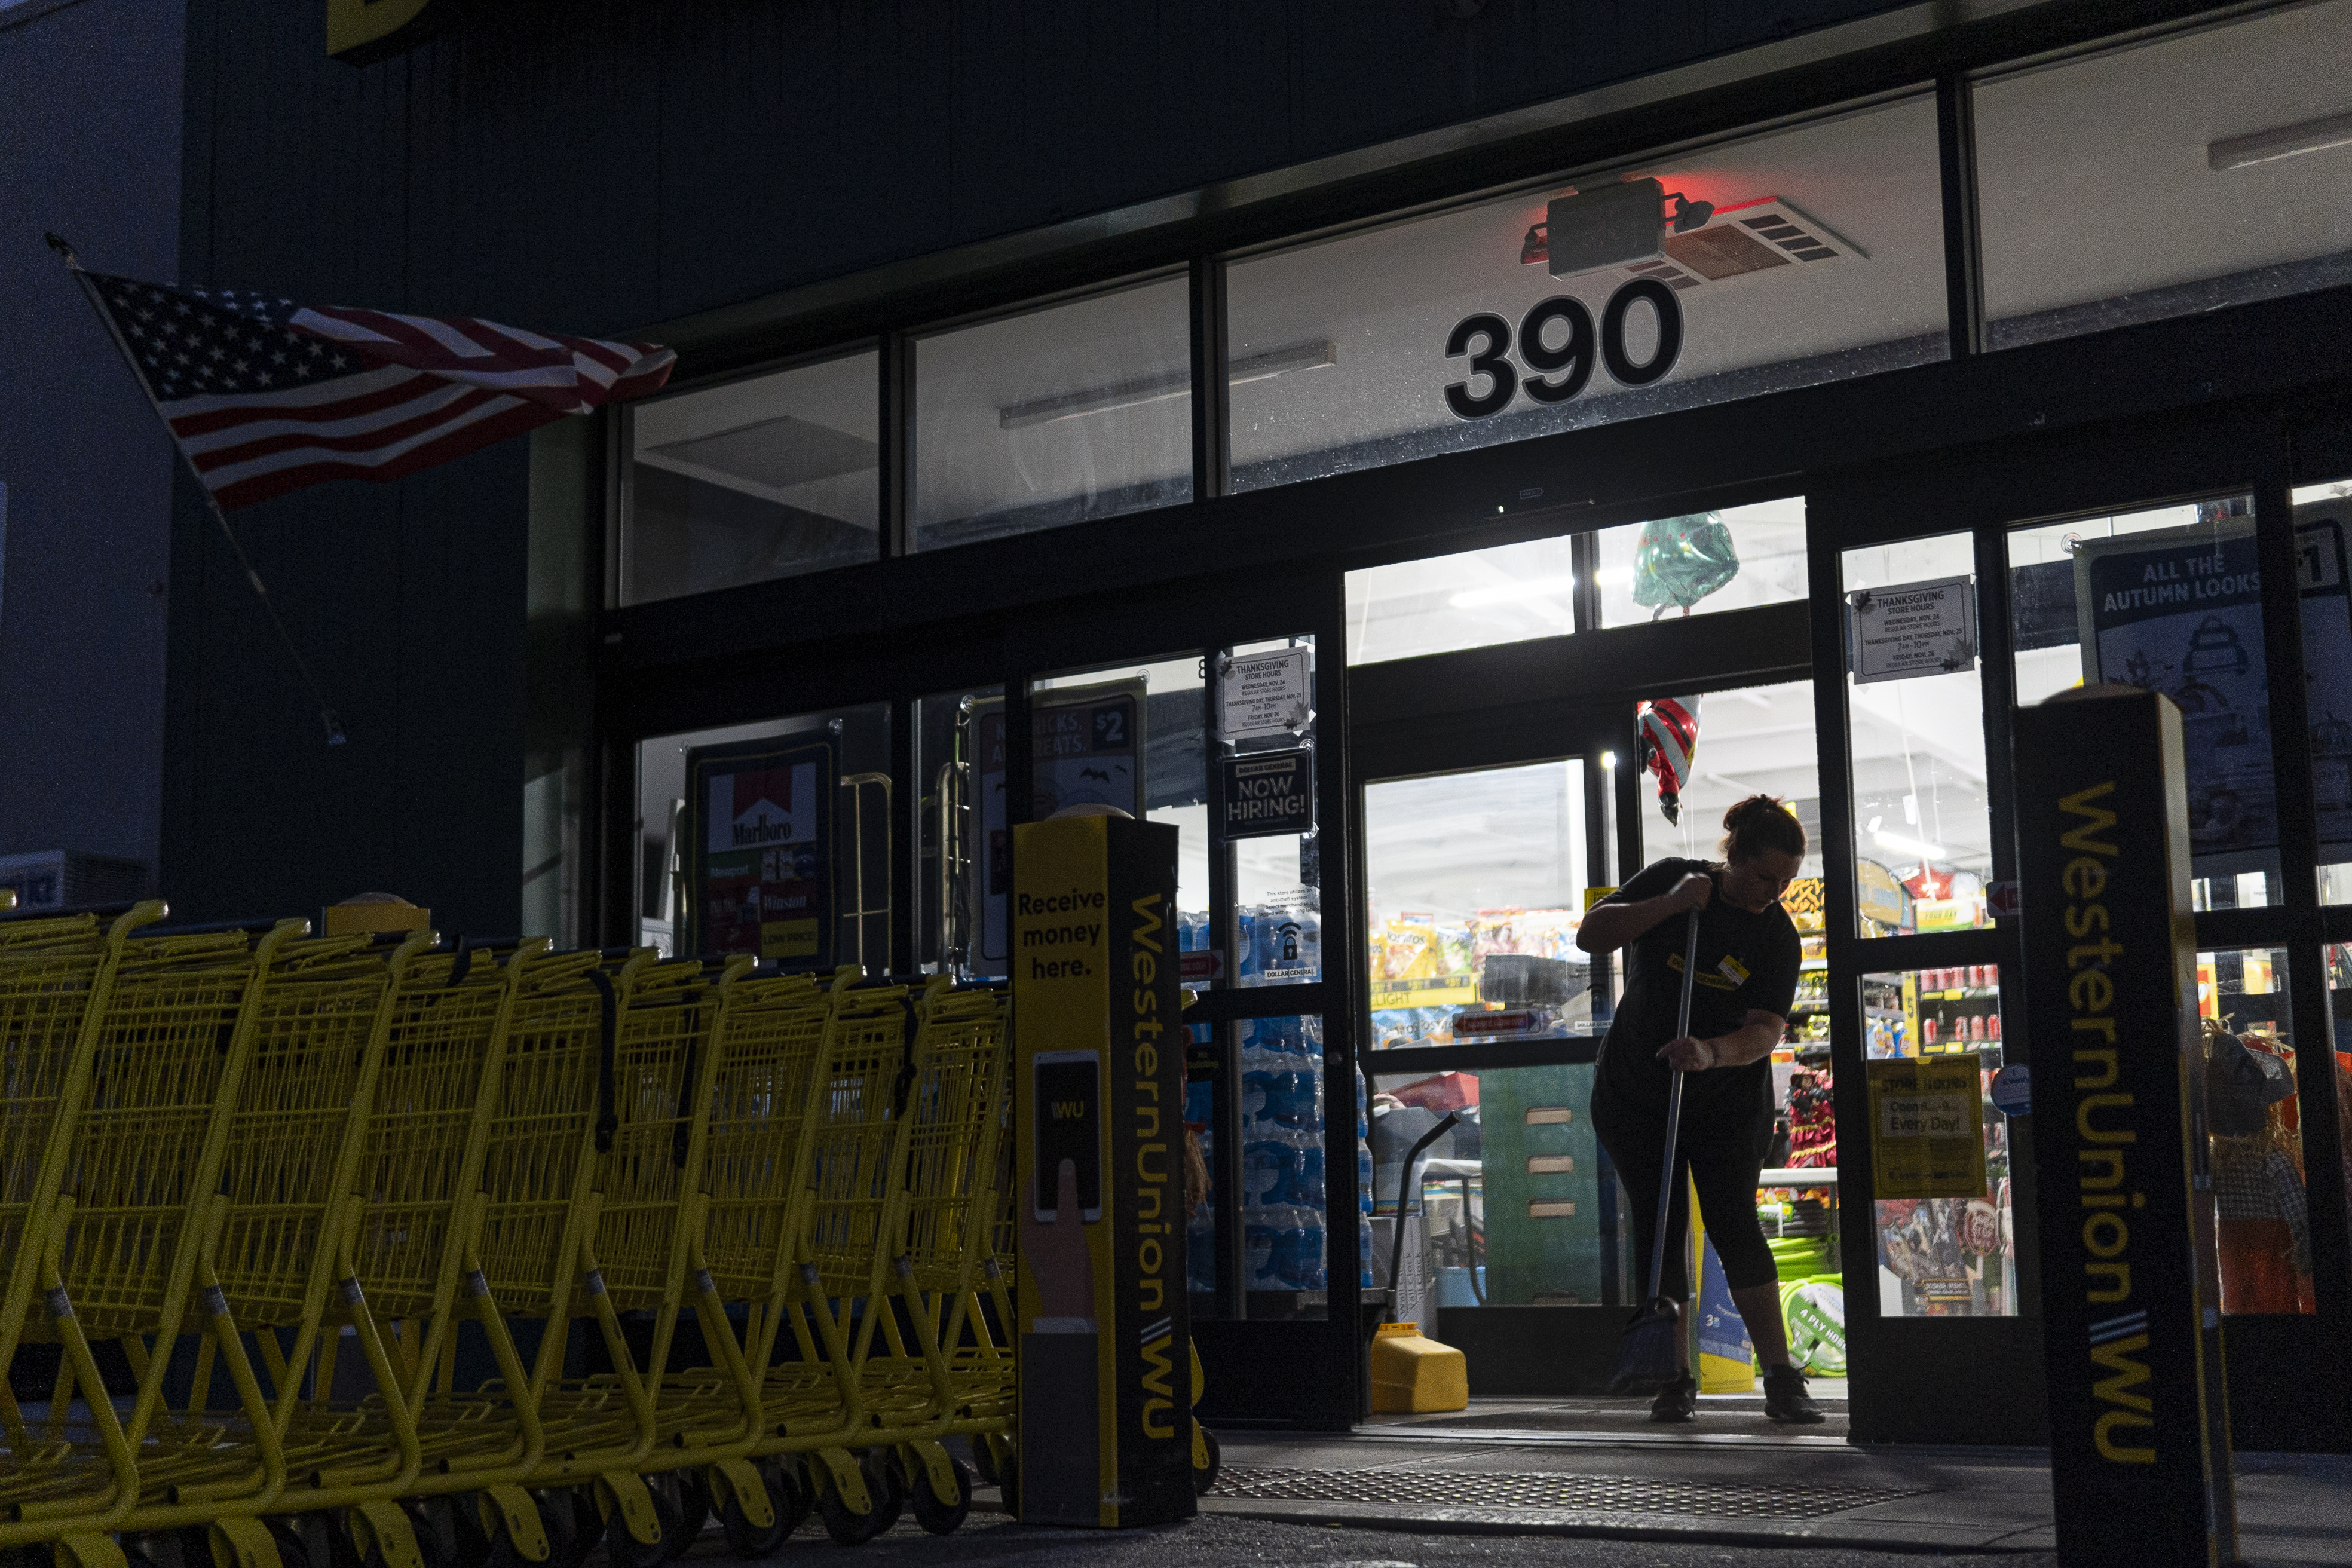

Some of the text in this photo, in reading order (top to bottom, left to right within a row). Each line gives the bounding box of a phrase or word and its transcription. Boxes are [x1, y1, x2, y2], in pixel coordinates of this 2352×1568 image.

[1444, 275, 1685, 421] 390
[2143, 553, 2225, 583] ALL THE
[1878, 591, 1944, 608] THANKSGIVING
[2103, 569, 2261, 612] AUTUMN LOOKS
[1888, 602, 1934, 615] STORE HOURS
[1865, 636, 1901, 645] THANKSGIVING
[1237, 659, 1288, 674] THANKSGIVING
[1263, 670, 1281, 678] HOURS
[1226, 699, 1255, 707] THANKSGIVING
[1033, 712, 1083, 734] RICKS.
[1095, 711, 1125, 742] $2
[1033, 737, 1087, 758] REATS.
[1239, 762, 1293, 774] DOLLAR GENERAL
[1239, 776, 1293, 800] NOW
[1229, 794, 1305, 821] HIRING!
[733, 813, 792, 846] Marlboro
[763, 895, 807, 910] Winston
[1019, 889, 1105, 916] Receive
[762, 931, 816, 944] LOW PRICE
[1024, 924, 1101, 947] money
[1033, 958, 1092, 979] here.
[1371, 992, 1411, 1006] ELIGHT
[1055, 1101, 1085, 1119] WU
[1891, 1101, 1919, 1114] Open
[1891, 1116, 1961, 1132] Every Day!
[1800, 1309, 1809, 1318] 4
[1808, 1315, 1827, 1331] PLY
[1141, 1334, 1175, 1439] WU
[2091, 1333, 2156, 1464] WU
